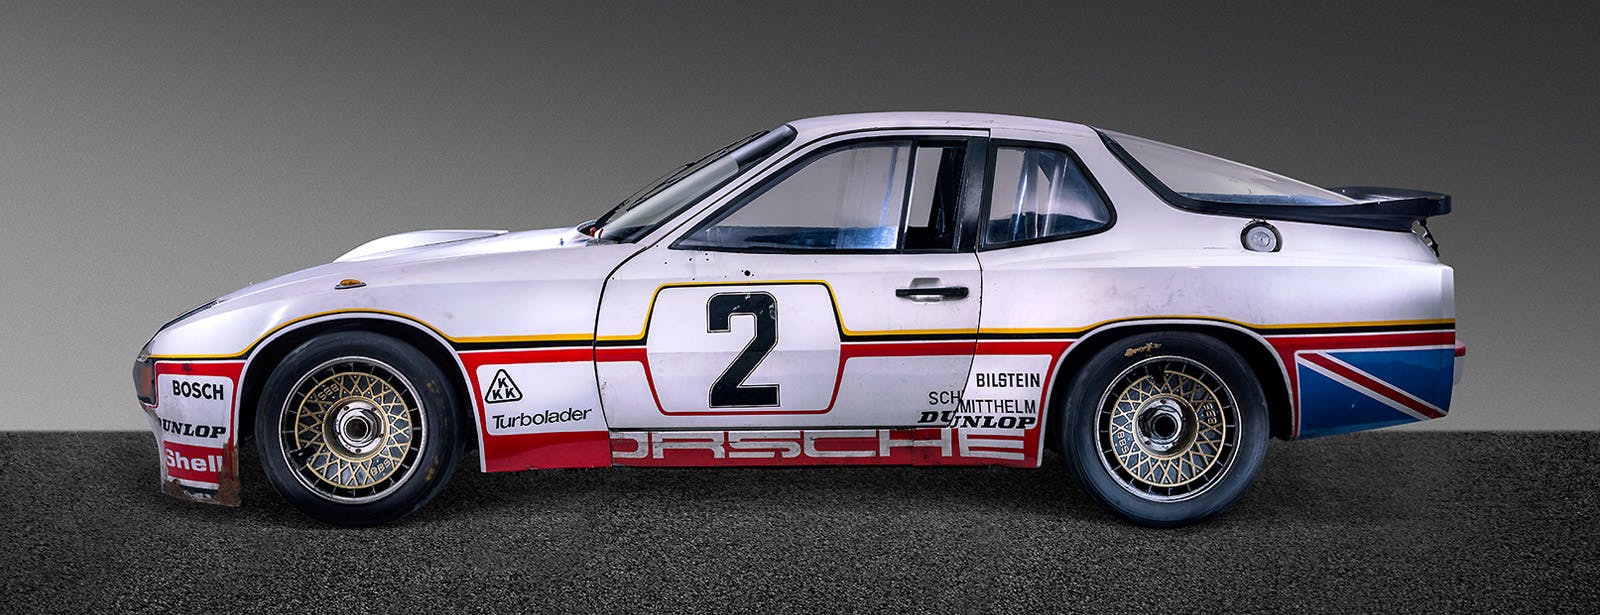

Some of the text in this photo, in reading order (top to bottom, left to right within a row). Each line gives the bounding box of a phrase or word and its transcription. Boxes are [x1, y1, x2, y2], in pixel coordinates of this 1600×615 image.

[706, 291, 780, 408] 2
[172, 379, 224, 400] BOSCH
[976, 373, 1040, 388] BILSTEIN
[158, 418, 227, 439] UNLOP
[492, 408, 592, 429] Turbolader
[917, 411, 1036, 429] DUNLOP
[165, 448, 223, 473] Shell
